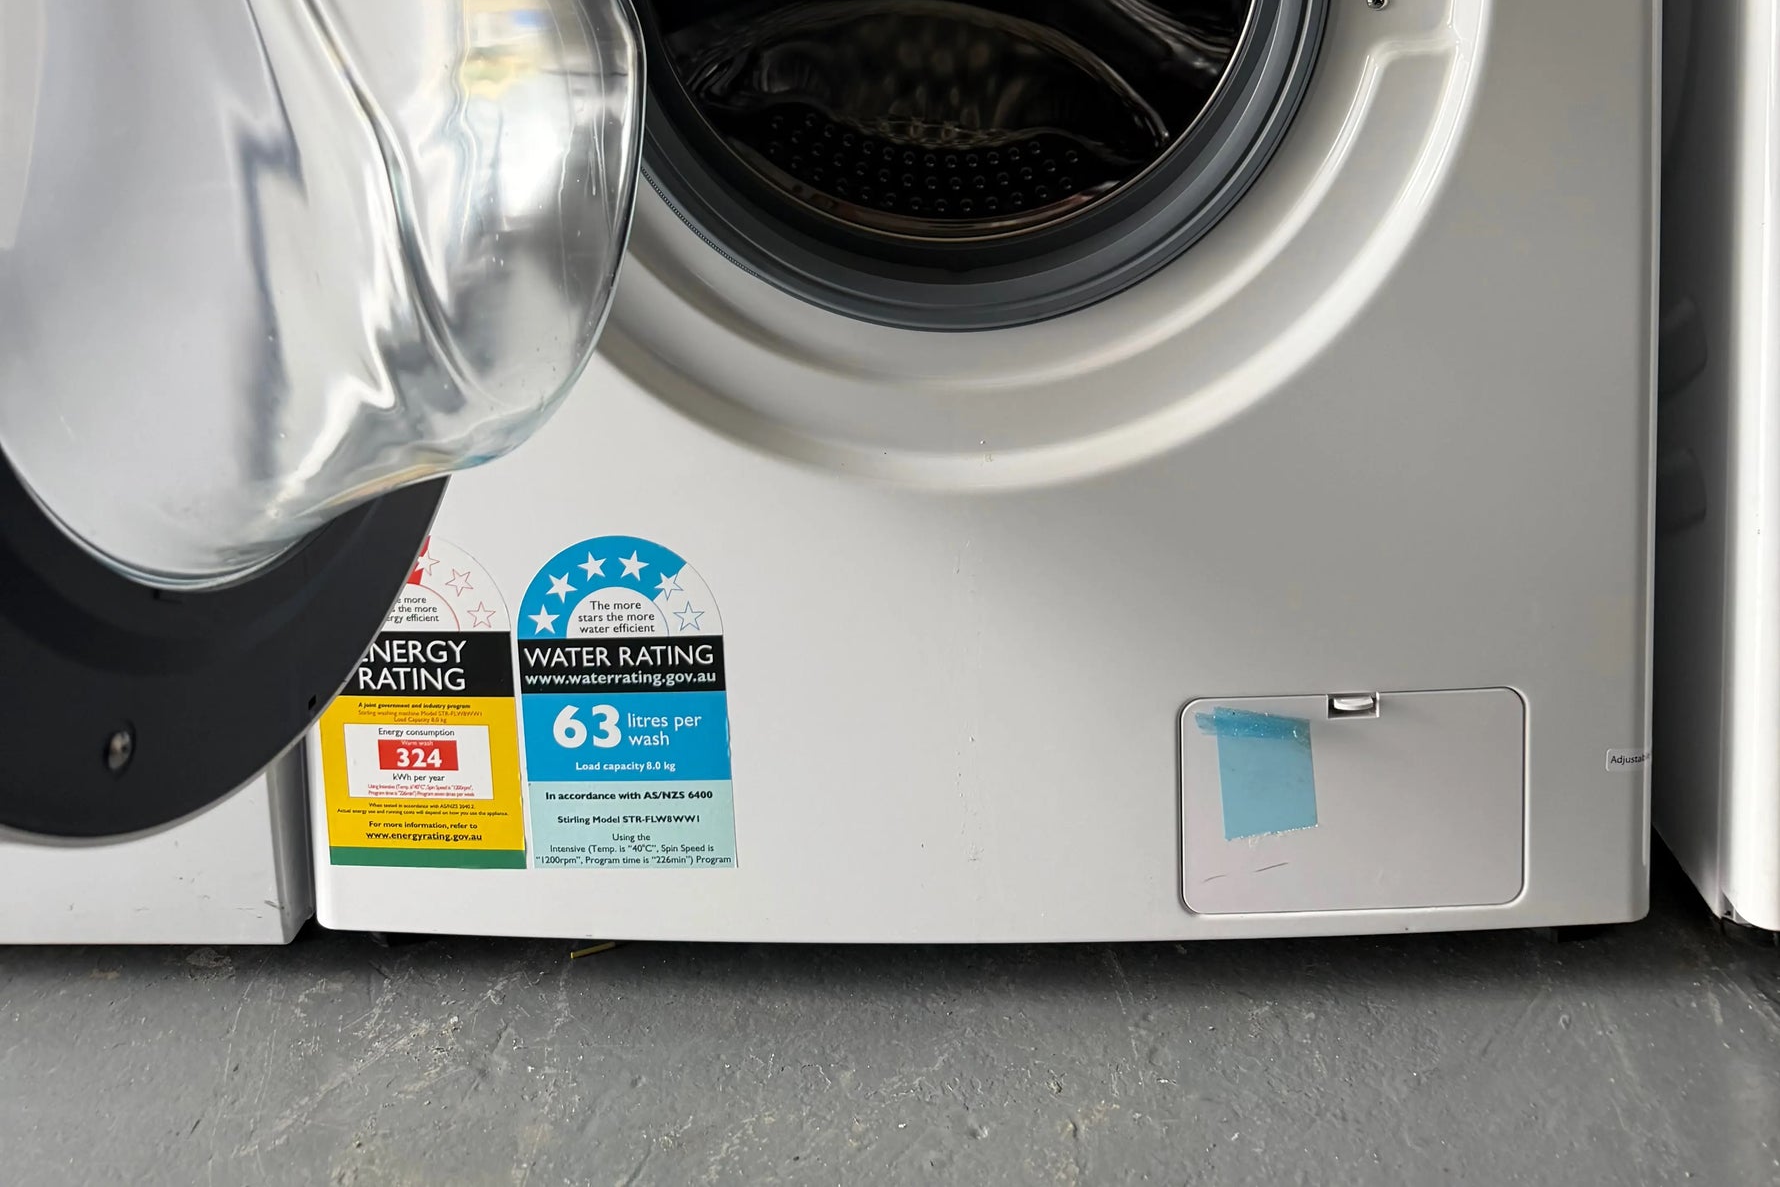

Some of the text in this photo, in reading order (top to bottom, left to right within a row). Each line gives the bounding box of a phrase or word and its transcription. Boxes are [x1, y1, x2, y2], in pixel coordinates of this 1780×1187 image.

[398, 604, 412, 613] the
[590, 600, 642, 611] The more
[406, 613, 440, 622] efficient
[578, 612, 655, 622] stars the more
[579, 623, 656, 634] water efficient
[361, 639, 467, 664] NERGY
[523, 645, 714, 668] WATER RATING
[358, 667, 466, 691] RATING
[525, 670, 717, 687] www.waterrating.gov.au
[552, 704, 622, 749] 63
[627, 712, 702, 732] litres per
[378, 727, 455, 738] Energy consumption
[628, 730, 670, 746] wash
[396, 747, 443, 768] 324
[575, 761, 676, 773] Load capacity 8.0 kg
[392, 773, 445, 783] kWh per year
[545, 790, 714, 801] In accordance with AS/NZS 6400
[368, 820, 381, 828] For
[557, 815, 591, 826] Stirling
[592, 815, 620, 824] Model
[366, 832, 483, 843] www.energyrating.gov.au
[611, 832, 651, 843] Using the
[549, 844, 585, 853] Intensive
[588, 844, 617, 855] (Temp.
[619, 844, 626, 853] is
[660, 844, 679, 855] Spin
[680, 843, 706, 854] Speed
[707, 843, 714, 852] is
[585, 856, 620, 867] Program
[622, 855, 640, 865] time
[642, 855, 650, 865] is
[695, 855, 732, 866] Program
